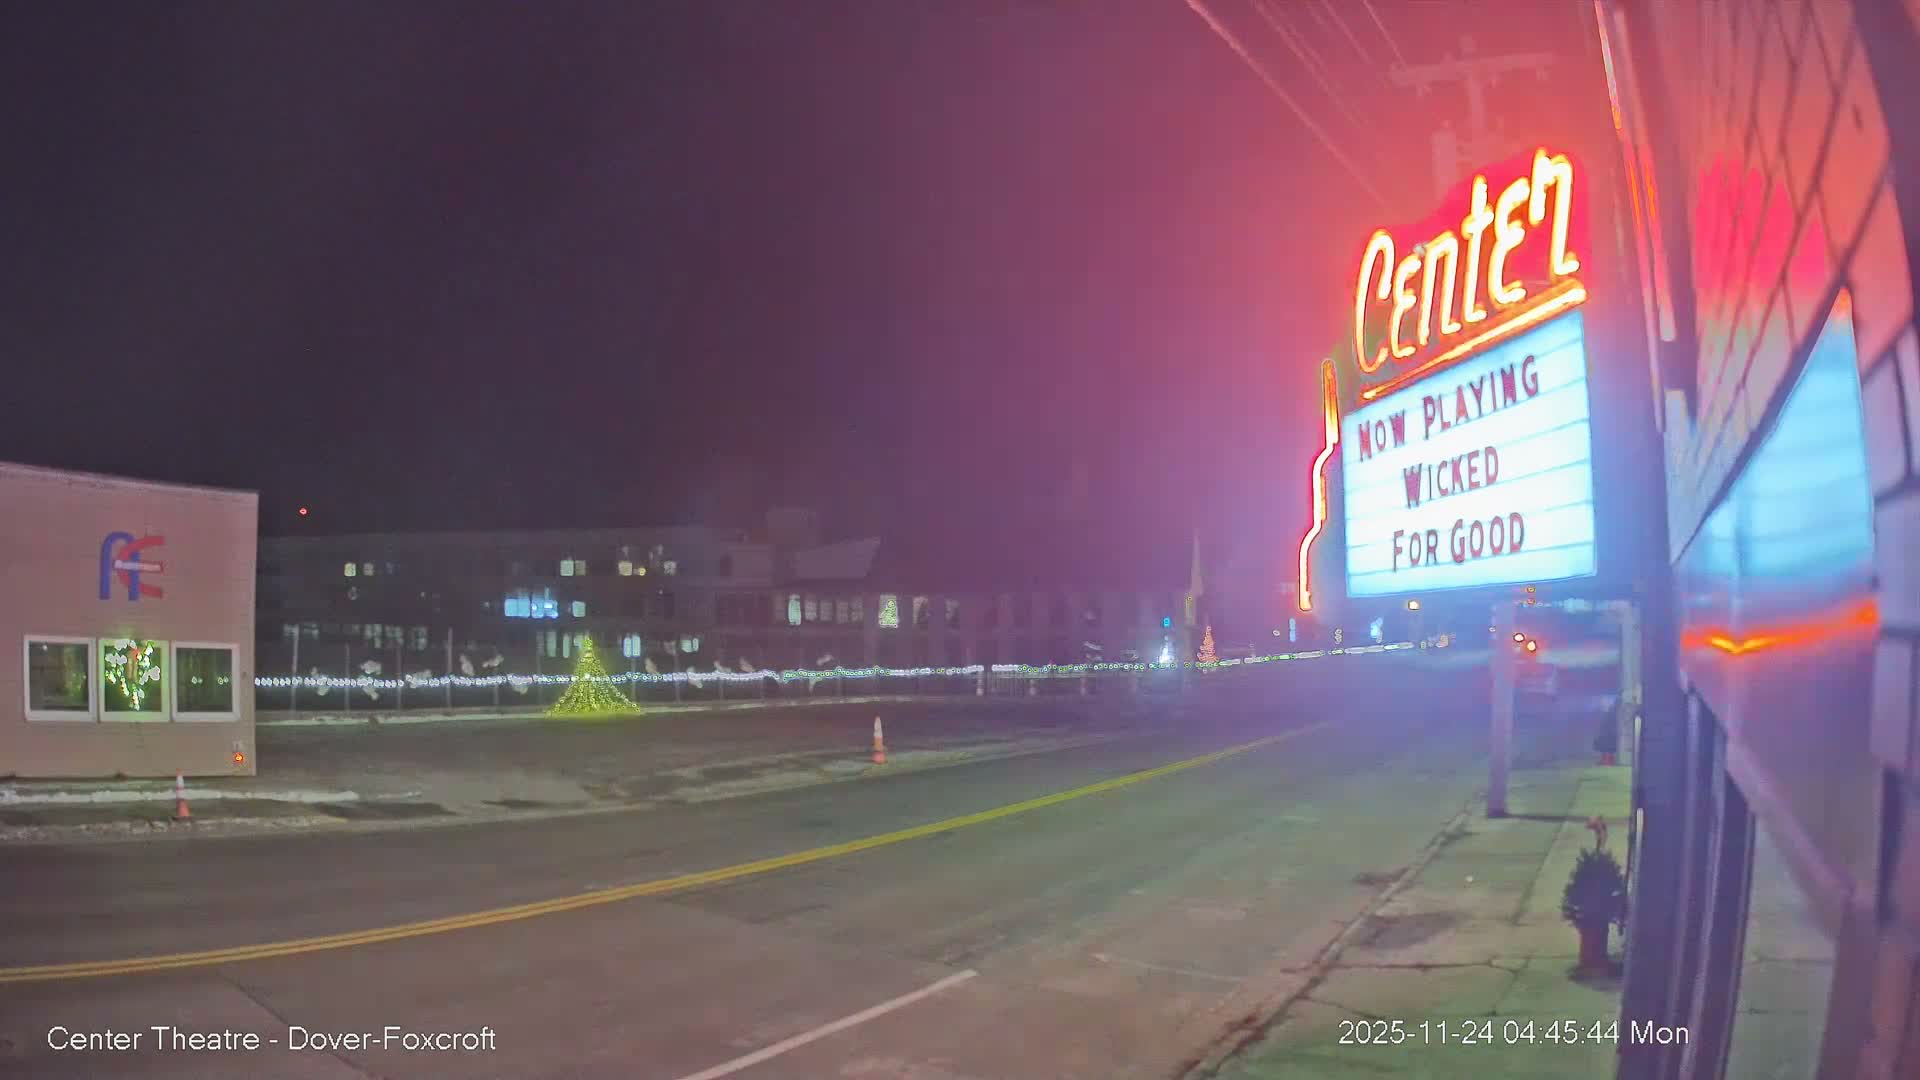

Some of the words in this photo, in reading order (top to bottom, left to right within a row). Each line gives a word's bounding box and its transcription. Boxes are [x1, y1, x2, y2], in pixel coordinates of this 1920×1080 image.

[1359, 409, 1405, 462] NOW
[1422, 355, 1539, 440] PLAYING
[1403, 446, 1500, 509] WICKED
[1393, 529, 1439, 572] FOR
[1451, 512, 1525, 564] GOOD
